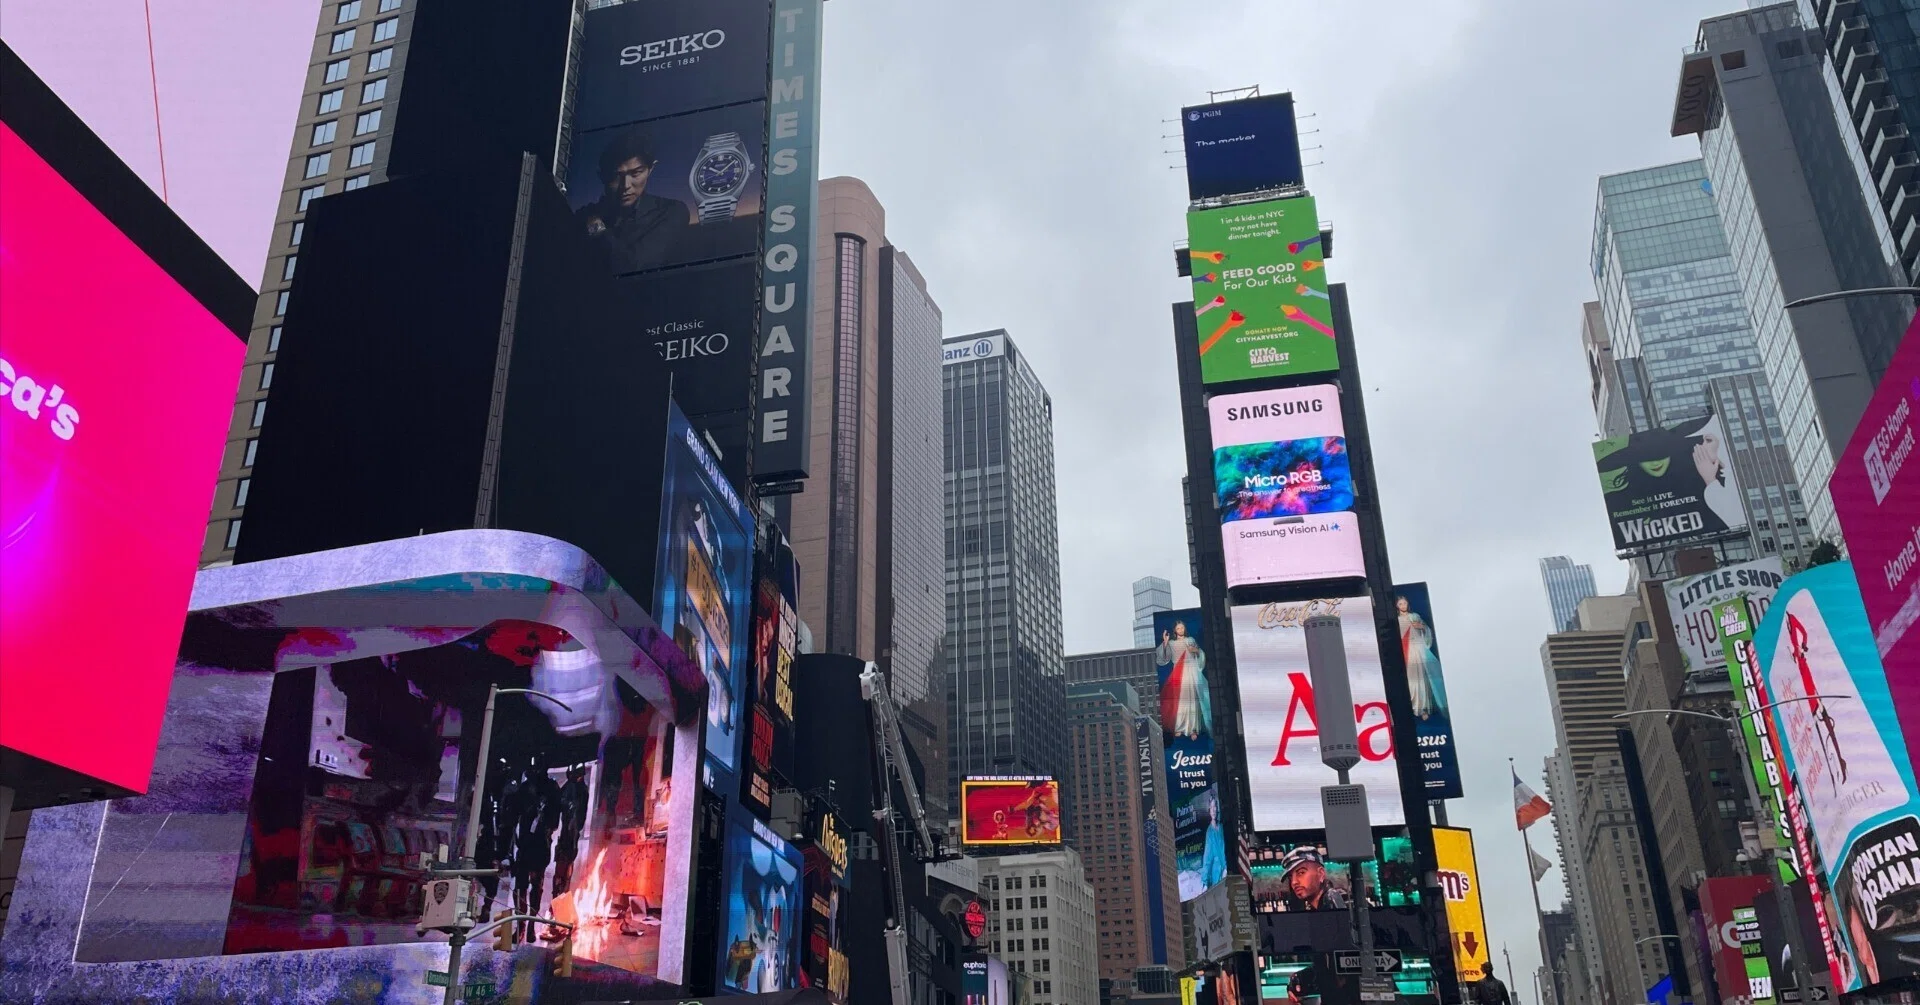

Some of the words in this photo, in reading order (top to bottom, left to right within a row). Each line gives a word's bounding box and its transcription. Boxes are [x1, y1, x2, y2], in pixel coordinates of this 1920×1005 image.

[619, 29, 726, 66] SEIKO
[642, 61, 673, 73] SINCE
[677, 56, 701, 67] 1881
[772, 8, 804, 175] TIMES
[1202, 109, 1222, 119] PGIM
[1241, 213, 1256, 222] kids
[1265, 209, 1285, 218] NYC
[1230, 225, 1245, 233] may
[1222, 268, 1253, 280] FEED
[1257, 263, 1296, 275] GOOD
[1223, 280, 1242, 291] For
[1246, 275, 1268, 289] Our
[1273, 271, 1297, 285] Kids
[664, 319, 705, 334] Classic
[761, 205, 798, 443] SQUARE
[1245, 327, 1271, 336] DONATE
[1249, 347, 1269, 357] CITY
[1250, 352, 1290, 365] HARVEST
[1227, 399, 1324, 421] SAMSUNG
[1876, 426, 1890, 456] 5G
[1885, 397, 1910, 441] Home
[1885, 424, 1916, 482] Internet
[1244, 474, 1287, 489] Micro
[1289, 469, 1323, 485] RGB
[1238, 490, 1253, 498] The
[1632, 498, 1645, 507] See
[1613, 506, 1652, 518] Remember
[1652, 503, 1659, 511] it
[1240, 527, 1287, 539] Samsung
[1289, 525, 1318, 535] Vision
[1320, 524, 1329, 532] AI
[1883, 541, 1917, 592] Home
[1679, 571, 1735, 610] LITTLE
[1736, 569, 1783, 590] SHOP
[1722, 592, 1735, 600] OF
[1720, 611, 1739, 627] DAILY
[1725, 620, 1747, 636] GREEN
[1733, 639, 1792, 839] CANNABIS
[1171, 750, 1213, 770] Jesus
[1424, 760, 1443, 771] you
[1184, 769, 1205, 779] trust
[1180, 781, 1189, 789] in
[1190, 781, 1207, 790] you
[1345, 957, 1361, 966] ON
[466, 986, 474, 997] W
[475, 985, 486, 997] 46
